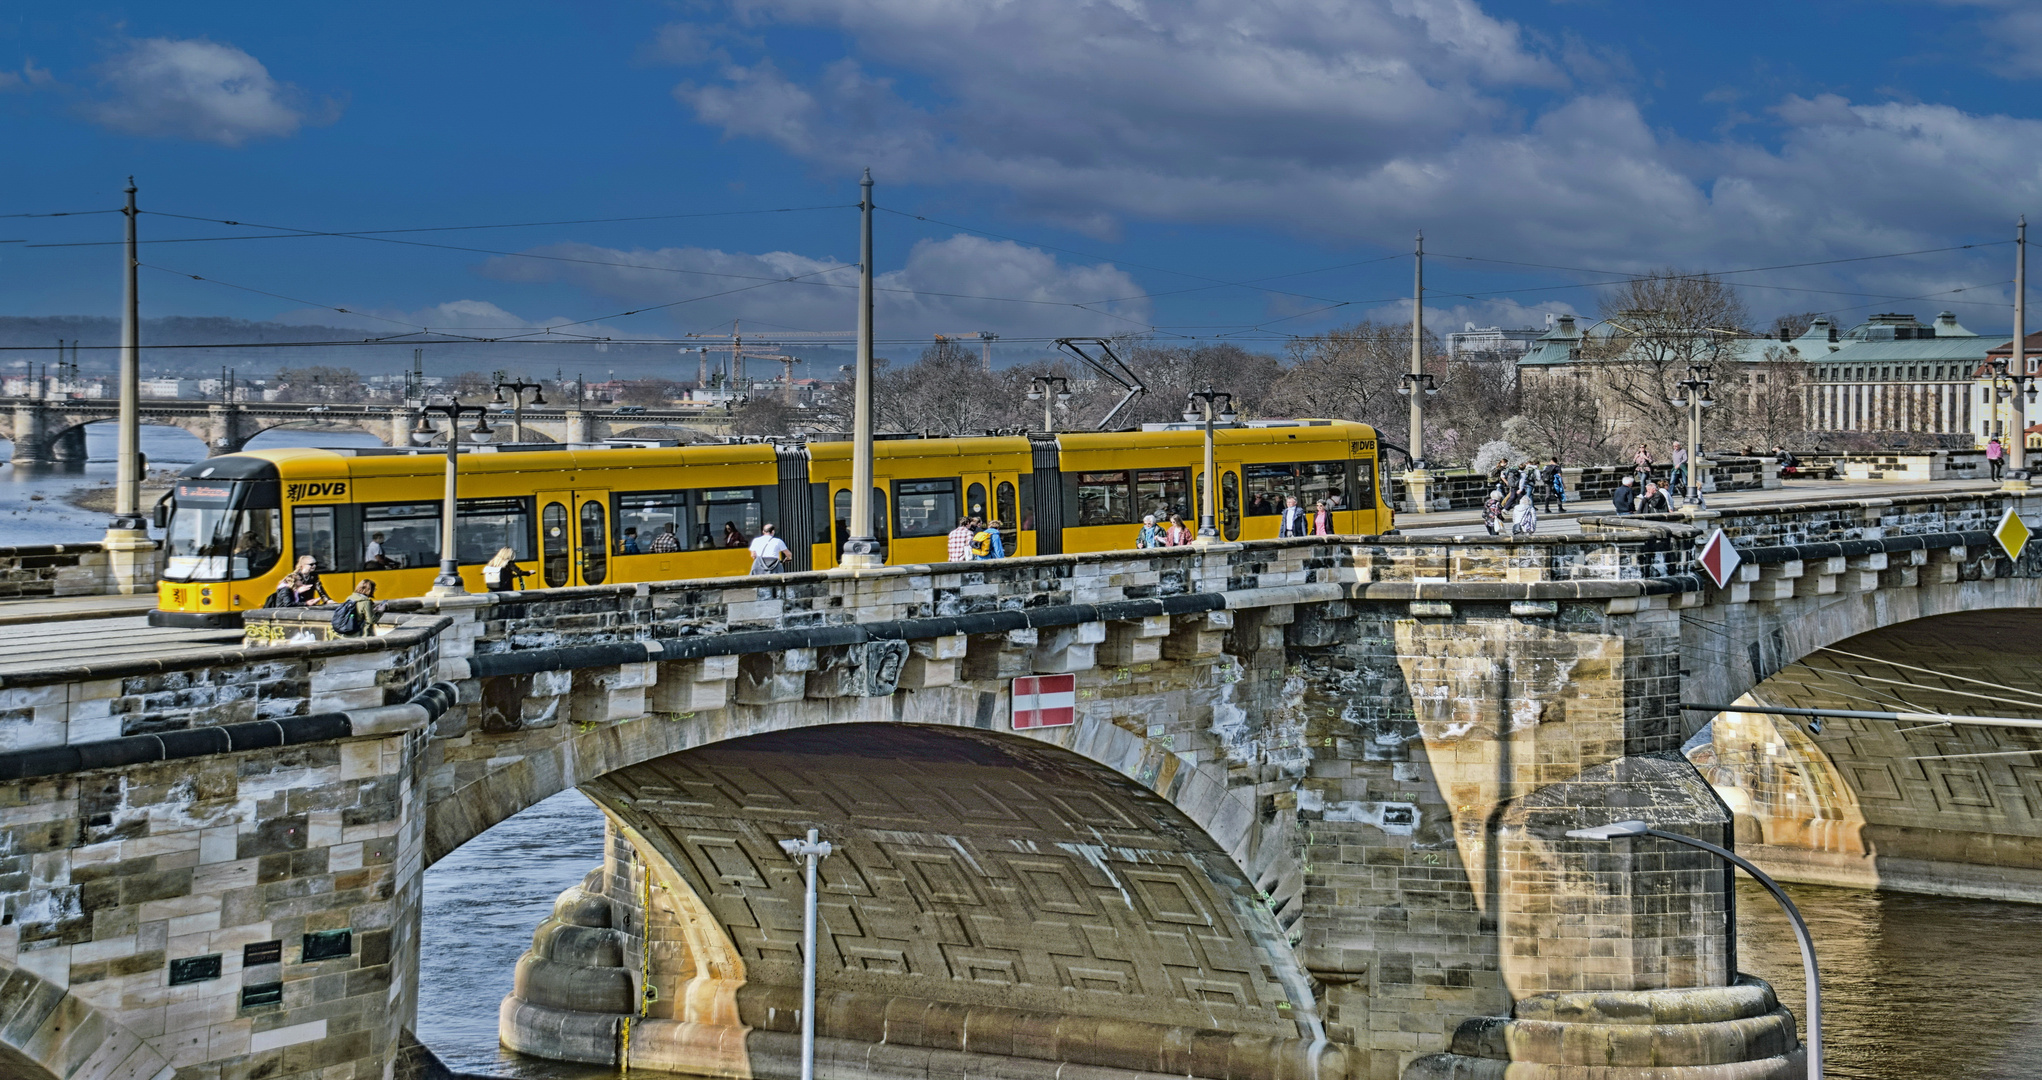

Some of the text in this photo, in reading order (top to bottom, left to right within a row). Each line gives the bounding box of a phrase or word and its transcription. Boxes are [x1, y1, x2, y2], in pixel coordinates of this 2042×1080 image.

[1360, 441, 1375, 450] DVB
[307, 483, 346, 496] DVB
[1162, 736, 1173, 748] 29
[1324, 738, 1332, 746] 9
[1423, 854, 1439, 865] 12
